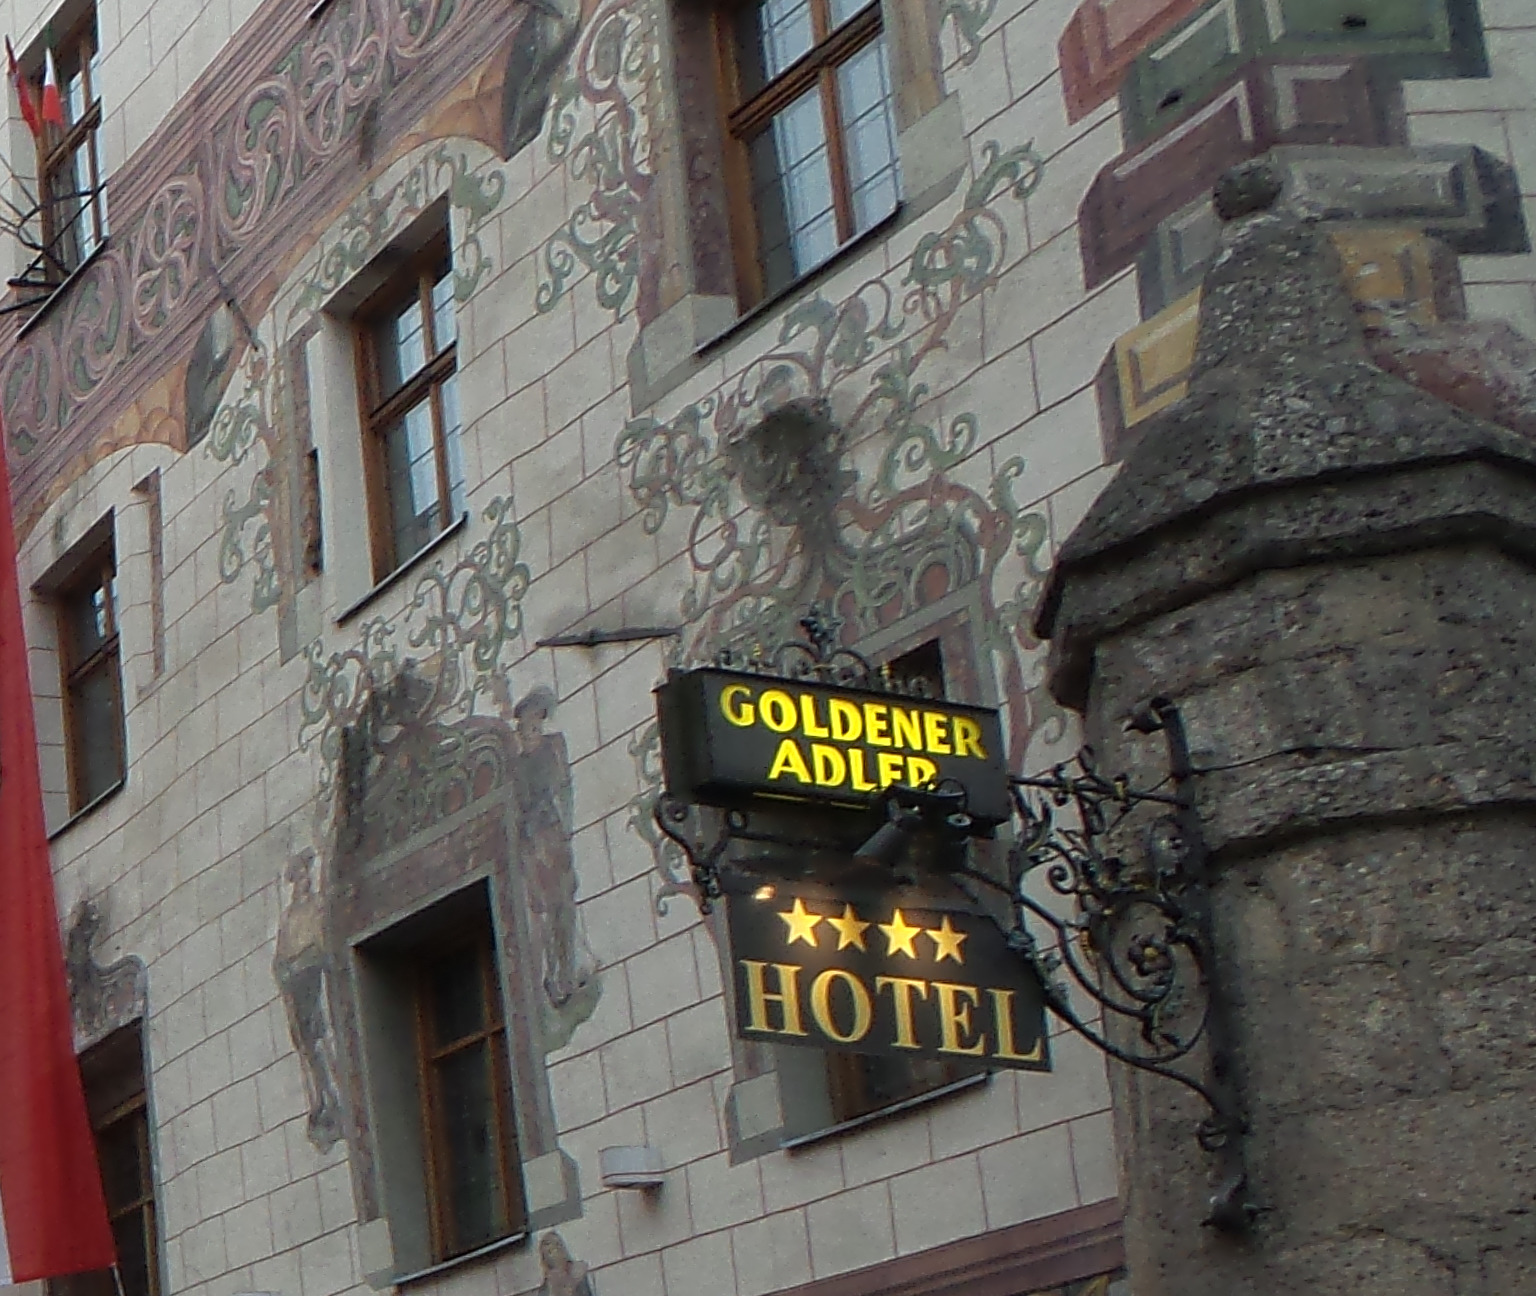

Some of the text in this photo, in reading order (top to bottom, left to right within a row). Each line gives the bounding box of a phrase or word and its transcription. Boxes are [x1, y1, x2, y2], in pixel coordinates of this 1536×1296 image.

[719, 684, 989, 760] GOLDENER
[767, 740, 938, 793] ADLER
[739, 959, 1044, 1063] HOTEL
